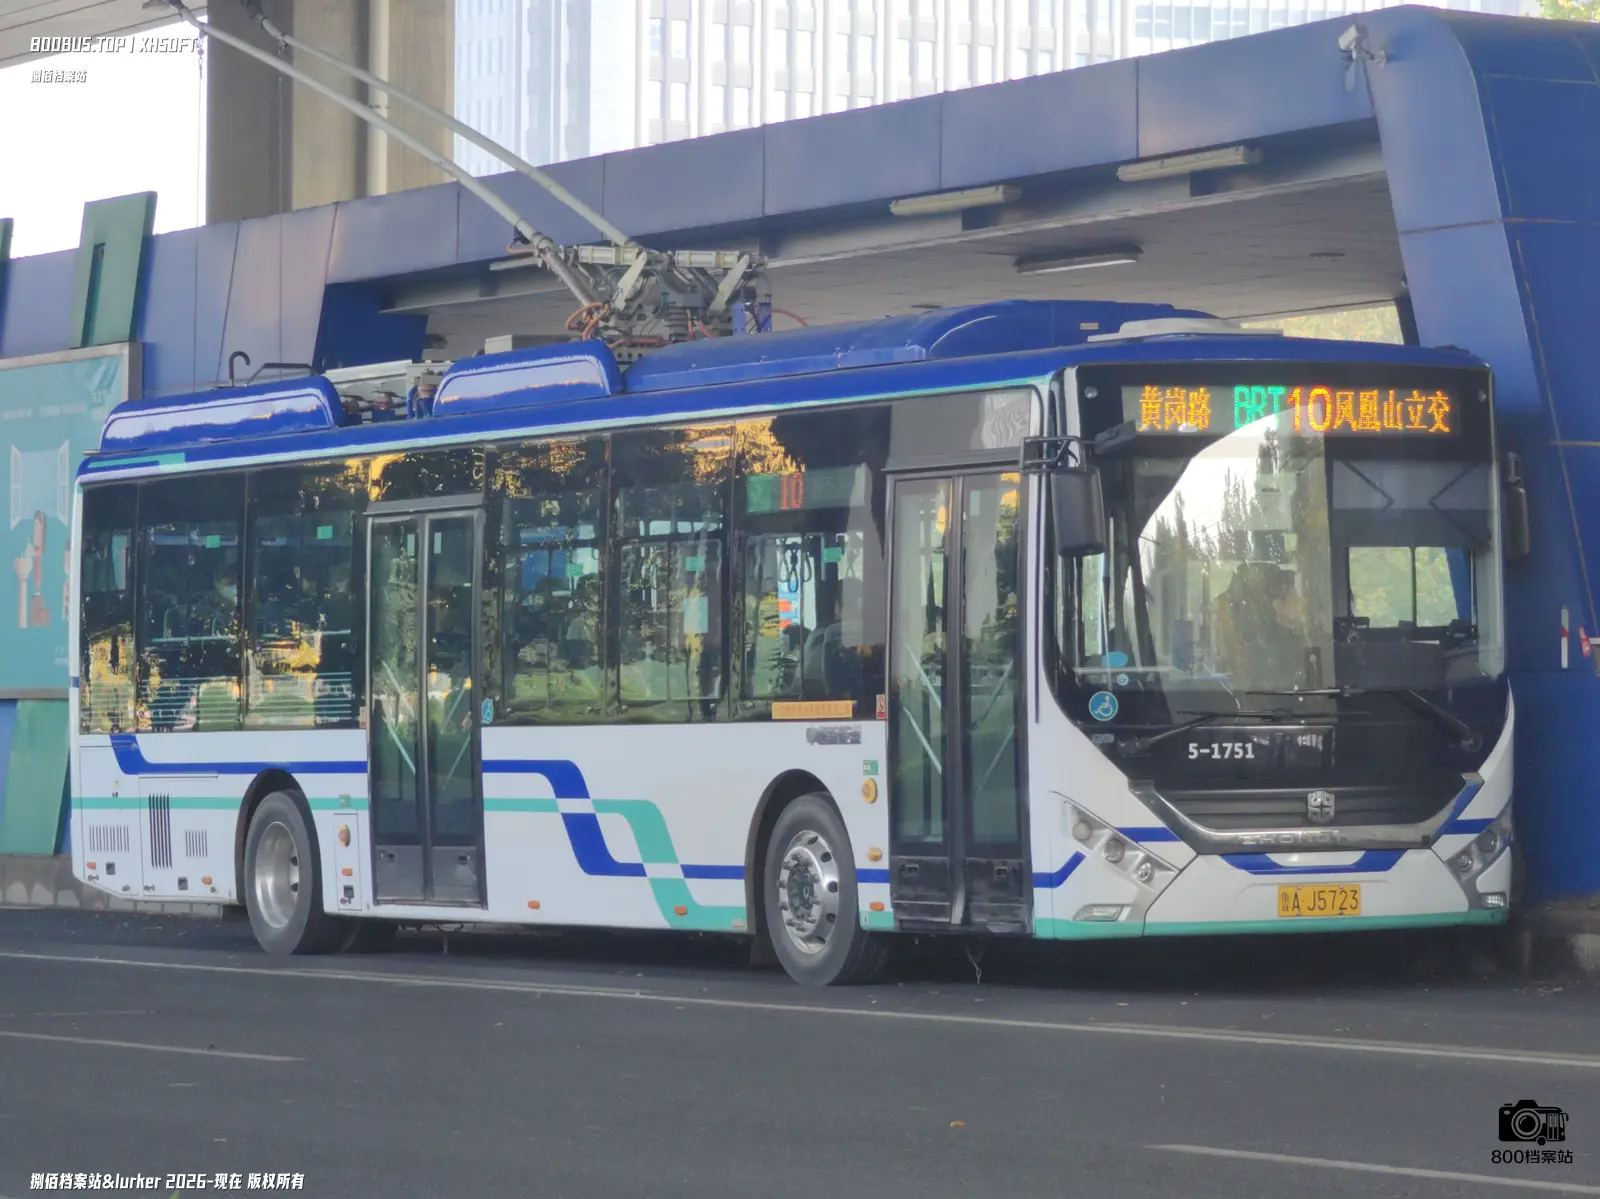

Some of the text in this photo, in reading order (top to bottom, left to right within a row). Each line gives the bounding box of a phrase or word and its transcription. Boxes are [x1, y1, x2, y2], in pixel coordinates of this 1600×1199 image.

[1138, 385, 1451, 433] 黄岗路 BRT 10 凤凰山立交
[1188, 742, 1255, 759] 5-1751
